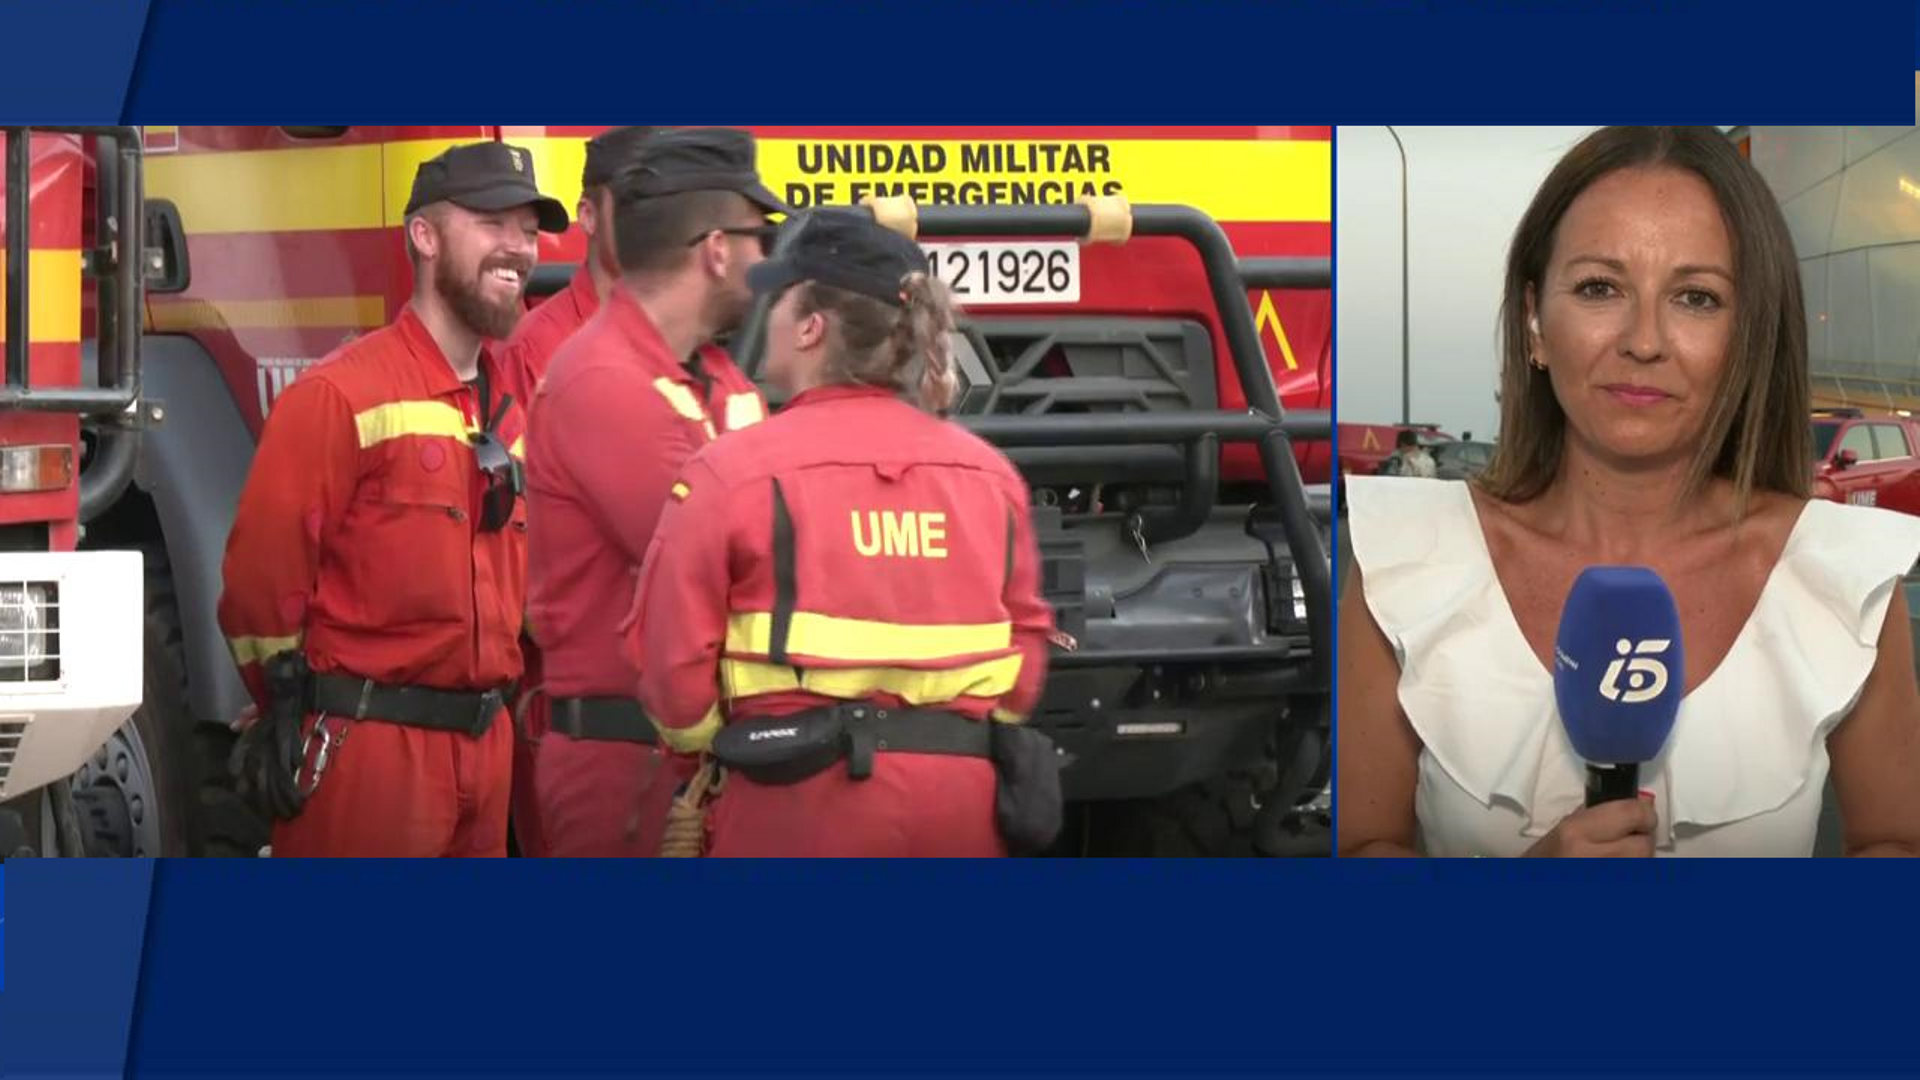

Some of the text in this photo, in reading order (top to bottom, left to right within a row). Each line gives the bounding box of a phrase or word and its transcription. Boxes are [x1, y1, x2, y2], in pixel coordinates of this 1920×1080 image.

[797, 143, 1111, 174] UNIDAD MILITAR
[785, 182, 834, 209] DE
[927, 250, 1071, 294] 121926
[851, 510, 948, 558] UME
